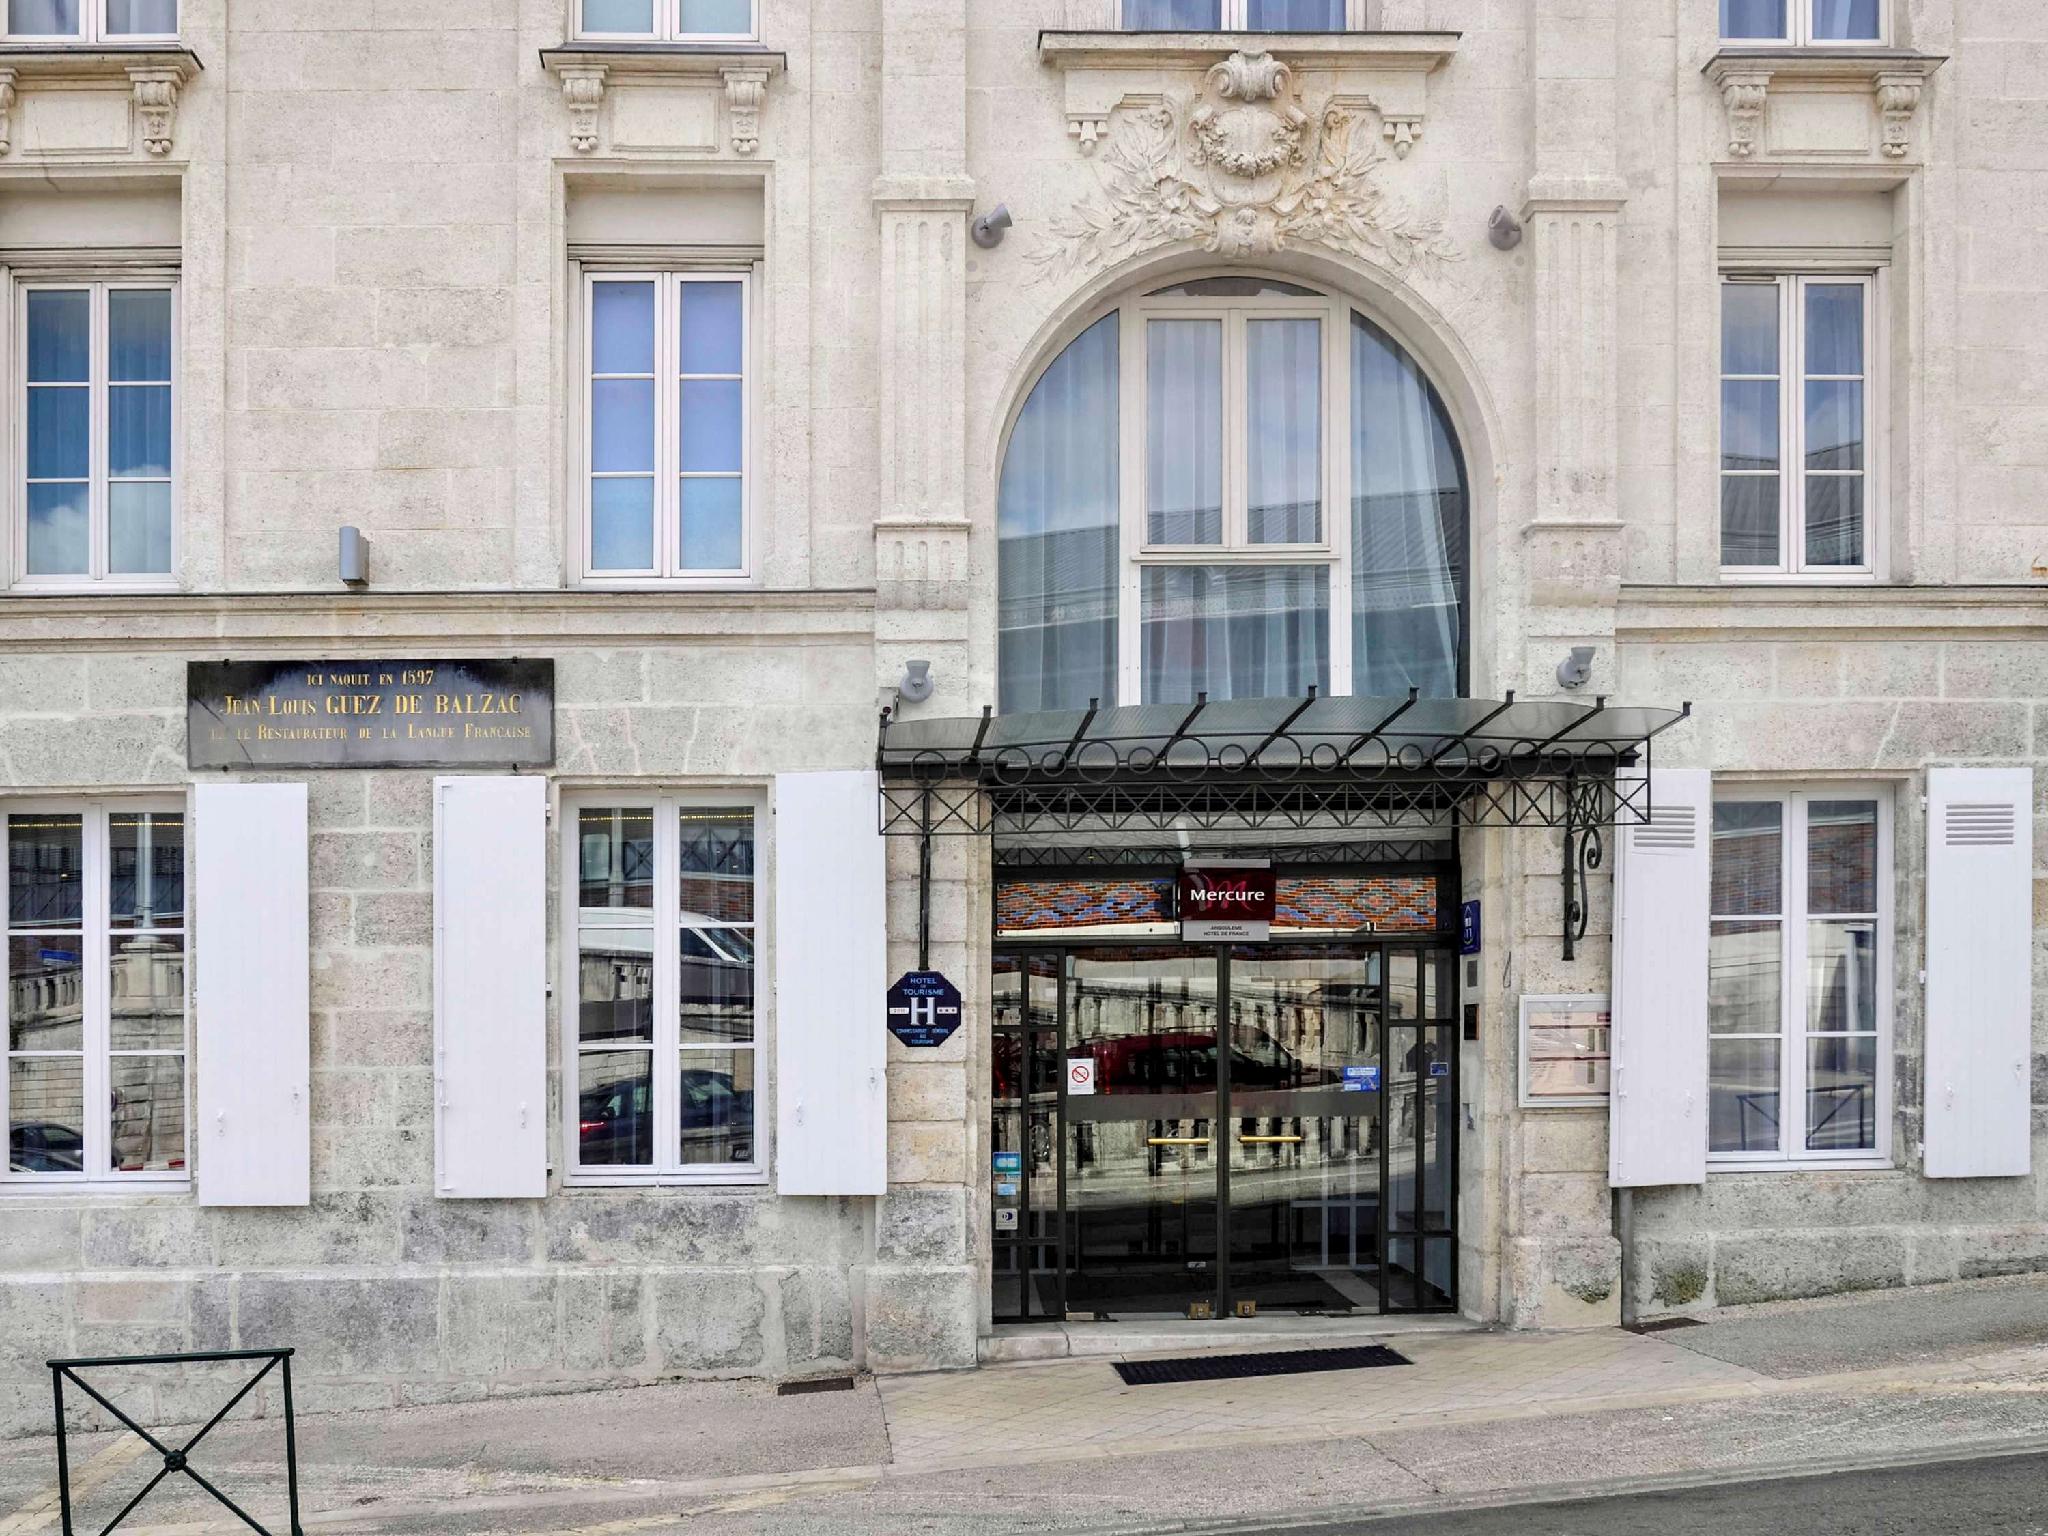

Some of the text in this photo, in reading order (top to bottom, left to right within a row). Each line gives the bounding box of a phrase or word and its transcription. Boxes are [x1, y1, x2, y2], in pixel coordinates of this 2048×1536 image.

[307, 673, 323, 686] ICI
[379, 673, 393, 686] EN
[402, 669, 434, 686] 1597
[326, 694, 382, 715] GUEZ
[395, 693, 423, 715] DE
[435, 693, 522, 715] BALZAC
[258, 723, 348, 741] RESTAURATEUR
[359, 727, 373, 740] DE
[383, 727, 397, 739] LA
[1190, 889, 1265, 901] Mercure
[903, 988, 945, 996] TOURISME
[910, 996, 937, 1026] H
